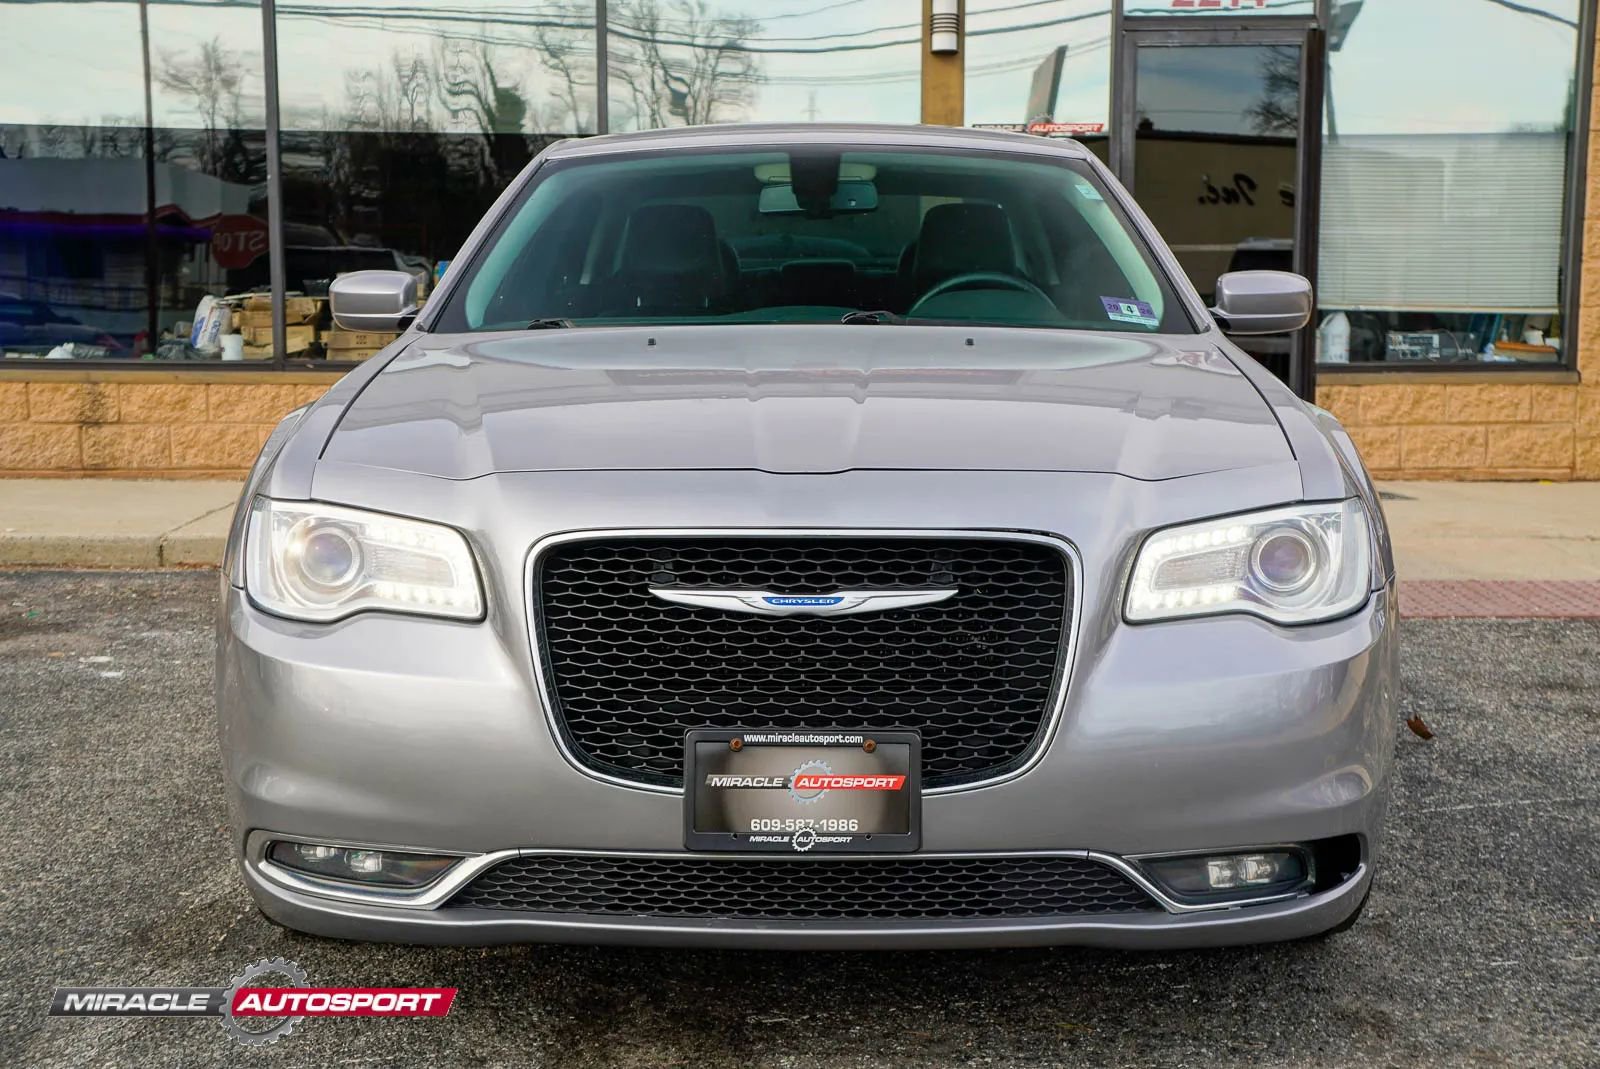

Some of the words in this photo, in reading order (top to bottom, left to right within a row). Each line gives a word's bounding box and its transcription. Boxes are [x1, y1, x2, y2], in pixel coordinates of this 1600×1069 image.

[1031, 123, 1101, 132] AUTOSPORT
[1126, 305, 1134, 315] 4
[744, 732, 863, 745] www.miracleautosport.com
[711, 777, 784, 787] MIRACLE
[797, 777, 898, 788] AUTOSPORT
[751, 819, 858, 831] 609-587-1986
[748, 835, 790, 843] MIRACLE
[796, 835, 853, 843] AUTOSPORT
